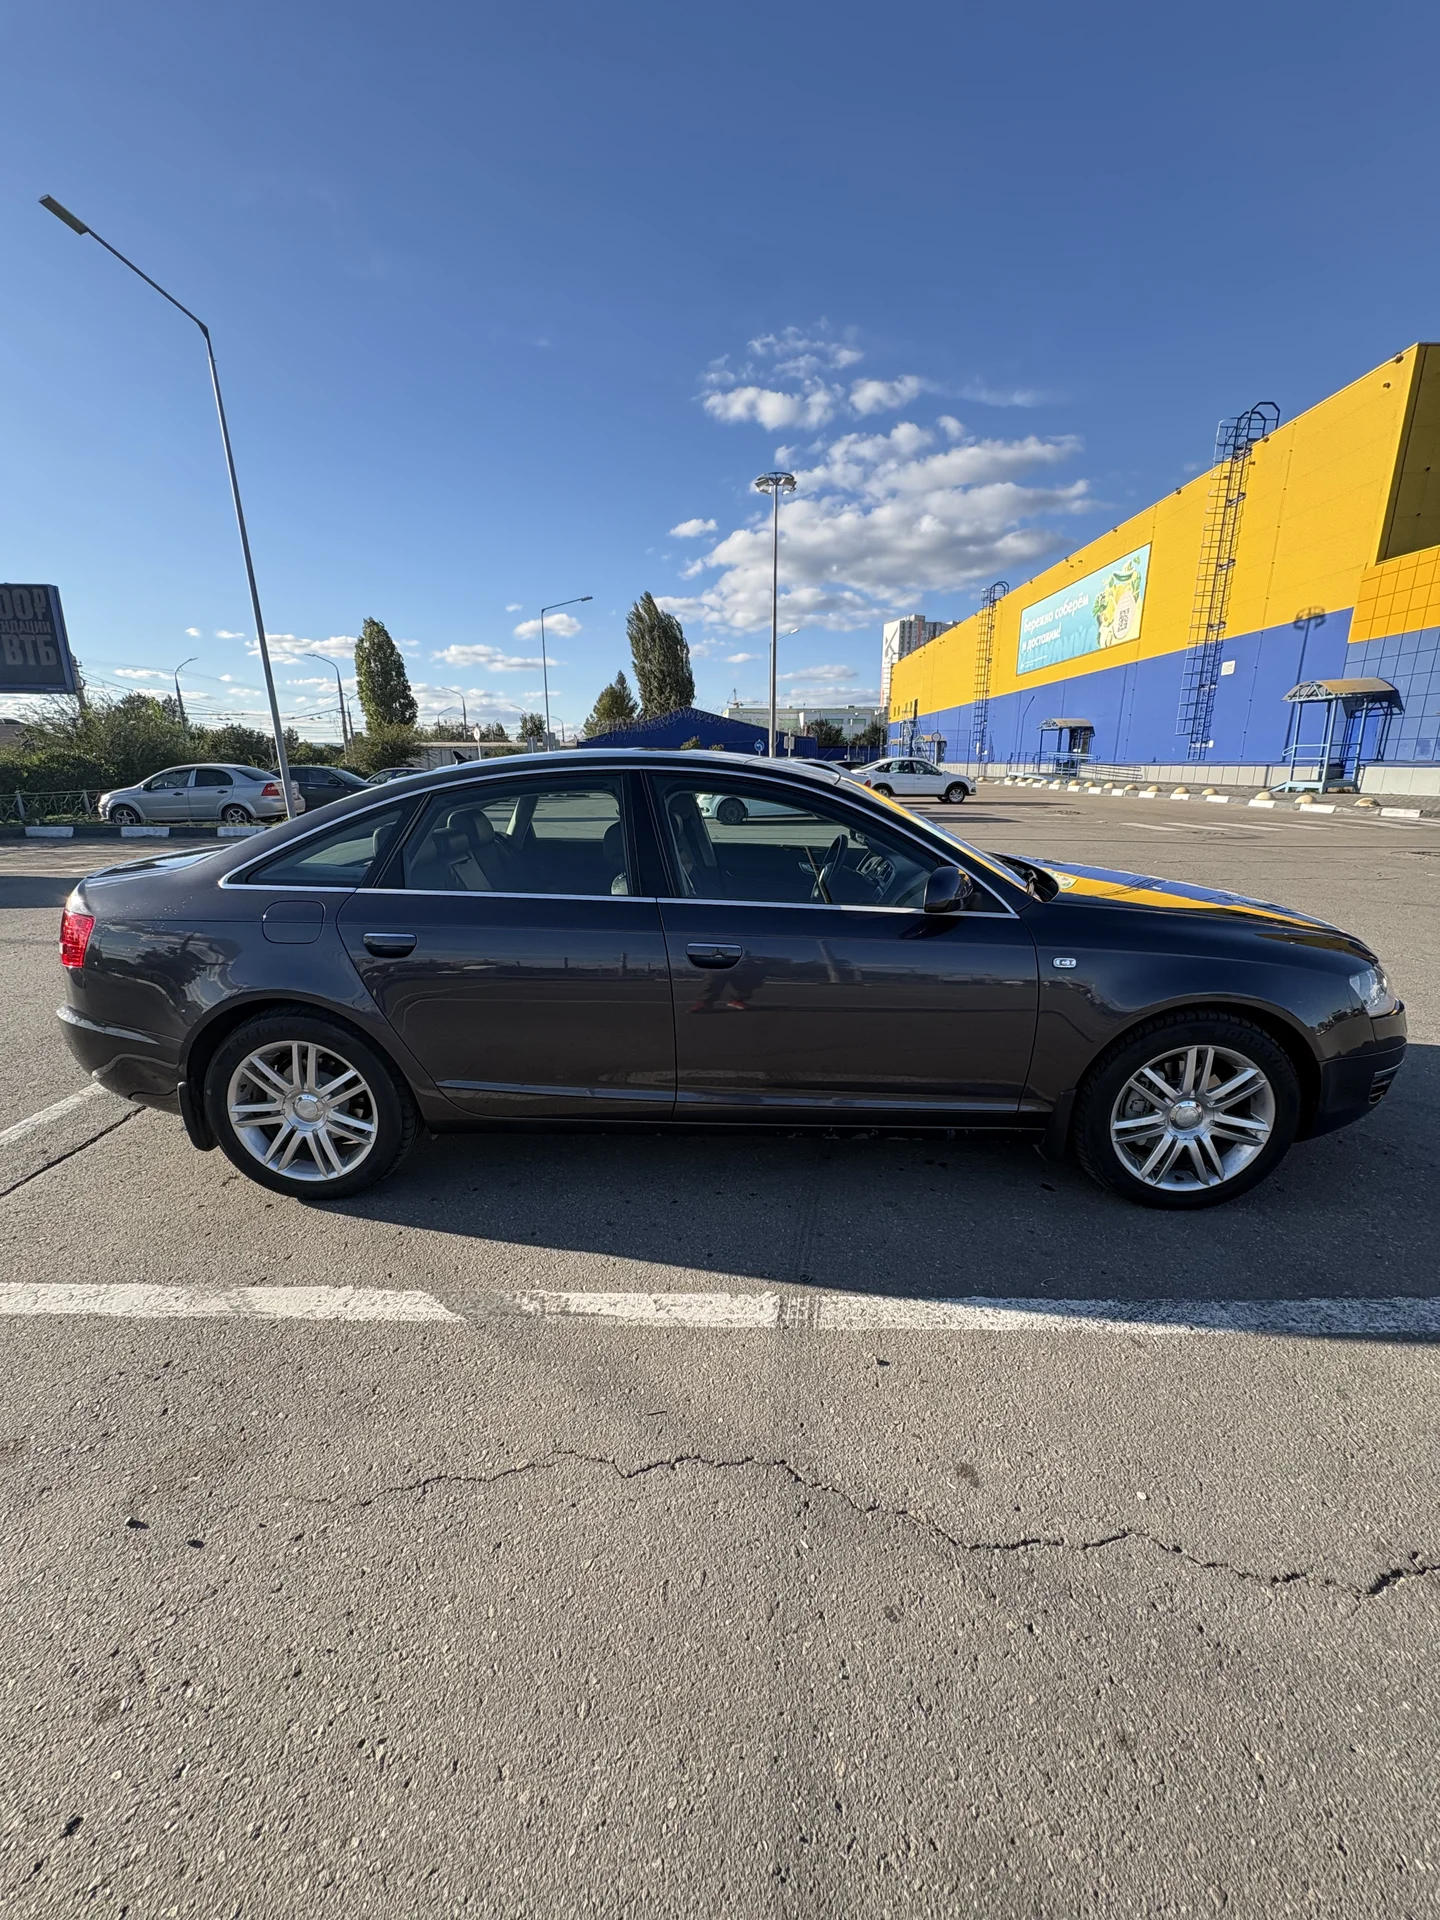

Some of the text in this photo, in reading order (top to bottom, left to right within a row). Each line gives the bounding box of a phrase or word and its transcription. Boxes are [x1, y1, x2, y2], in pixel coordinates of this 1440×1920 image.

[1023, 592, 1089, 635] Бережно соберём
[2, 633, 57, 666] ВТБ
[1022, 640, 1027, 653] и
[1026, 622, 1062, 652] доставим!
